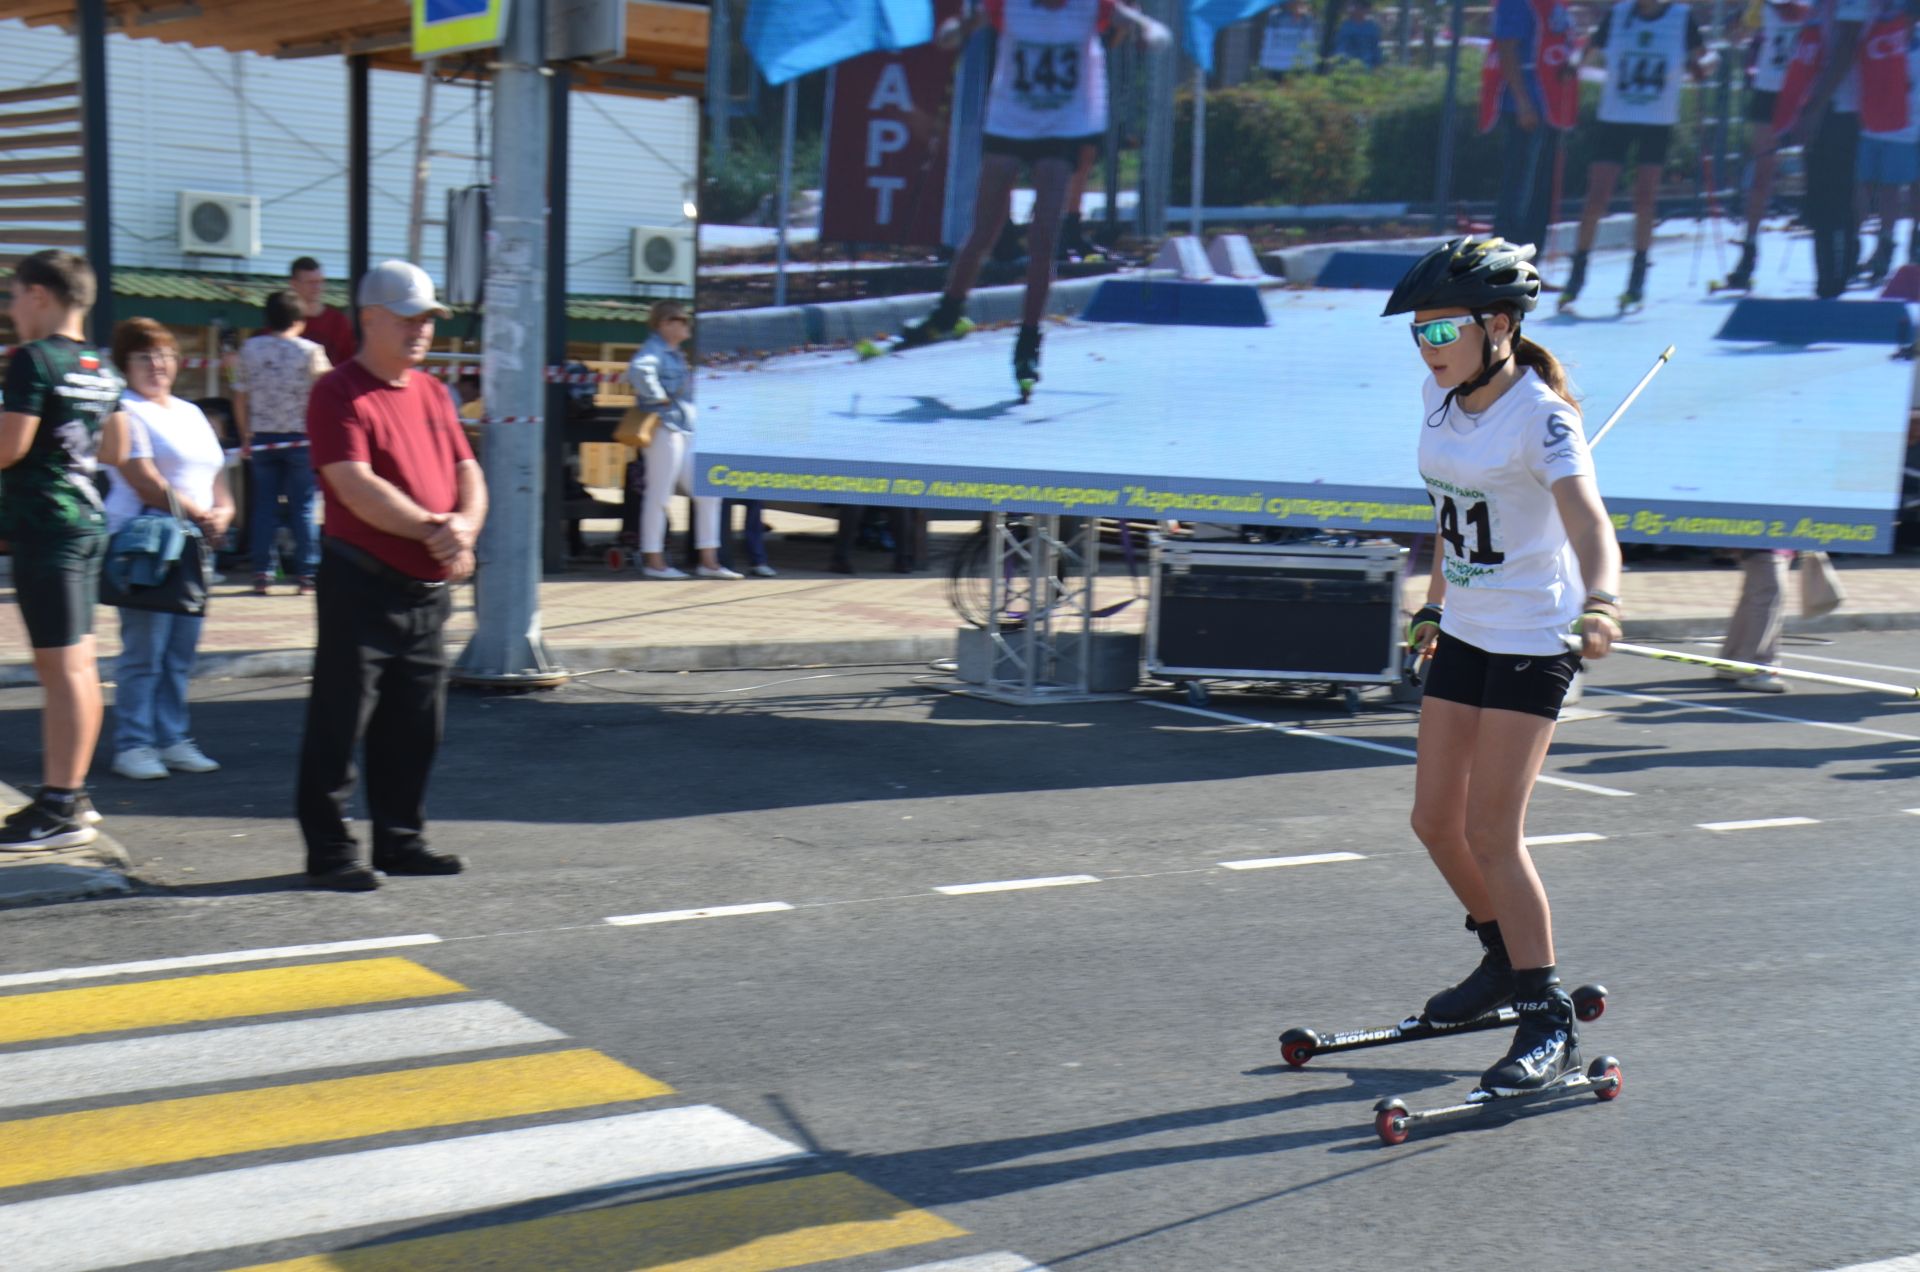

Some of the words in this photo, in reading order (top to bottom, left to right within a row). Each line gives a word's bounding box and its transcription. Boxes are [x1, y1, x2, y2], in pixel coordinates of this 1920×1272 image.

[1013, 46, 1079, 93] 143
[1616, 54, 1668, 93] 144
[865, 62, 913, 225] АРТ
[1427, 492, 1505, 565] 41
[1516, 1001, 1549, 1012] TISA
